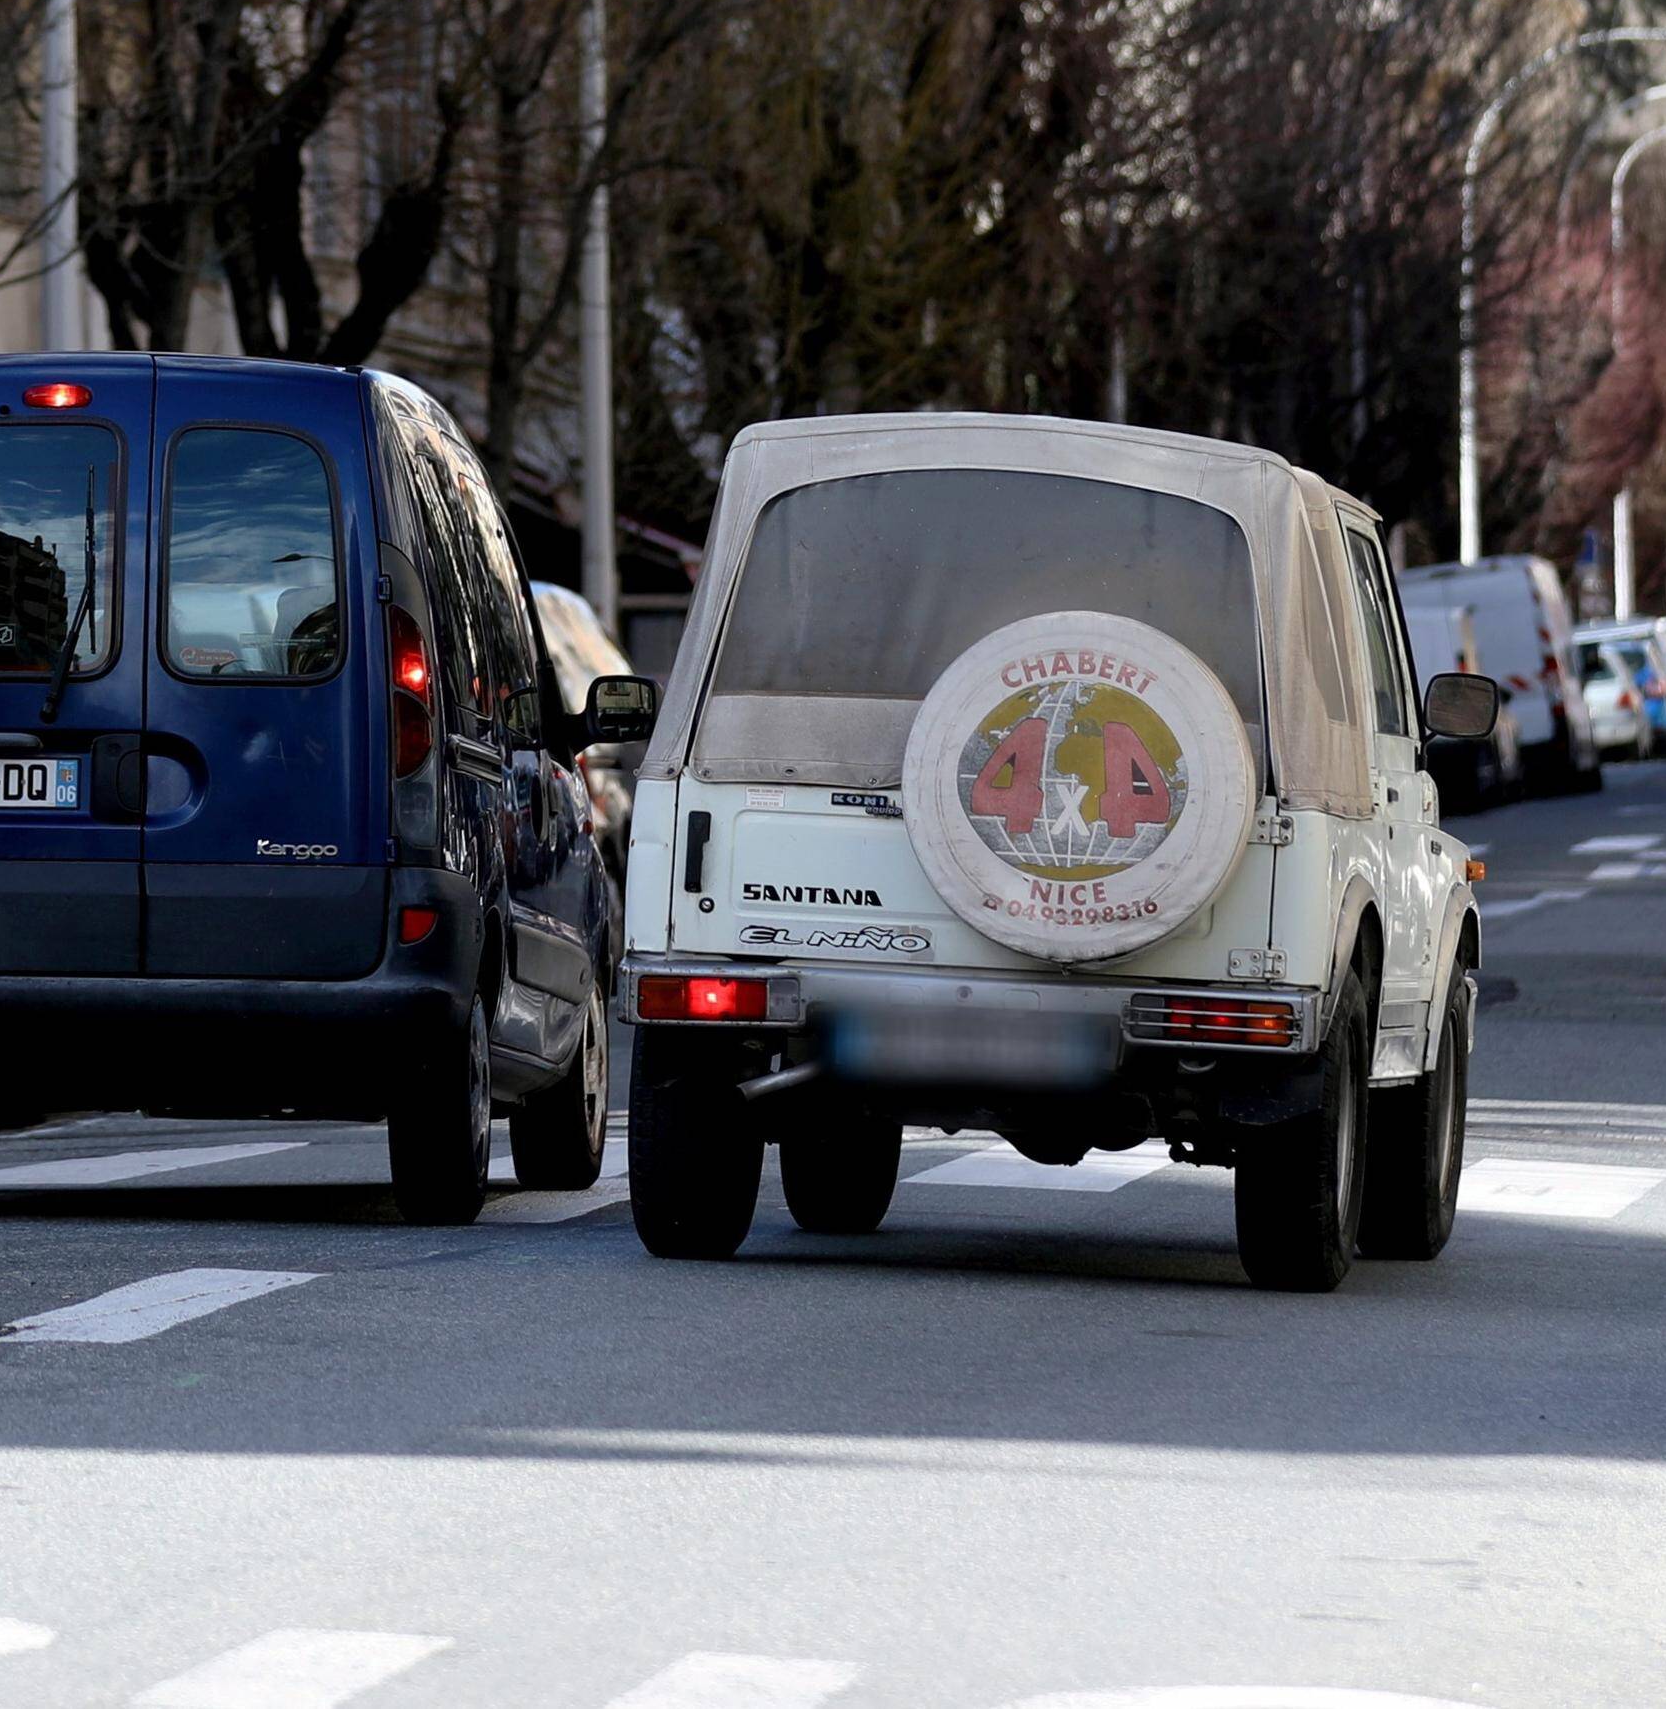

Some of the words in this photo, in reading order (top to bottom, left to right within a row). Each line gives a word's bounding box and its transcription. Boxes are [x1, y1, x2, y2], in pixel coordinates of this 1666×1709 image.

[1000, 650, 1159, 694] CHABERT
[56, 785, 77, 802] 06
[833, 794, 885, 806] KONI
[256, 839, 339, 860] Kangoo
[743, 883, 882, 907] SANTANA
[1029, 881, 1108, 906] NICE
[739, 925, 803, 945] EL
